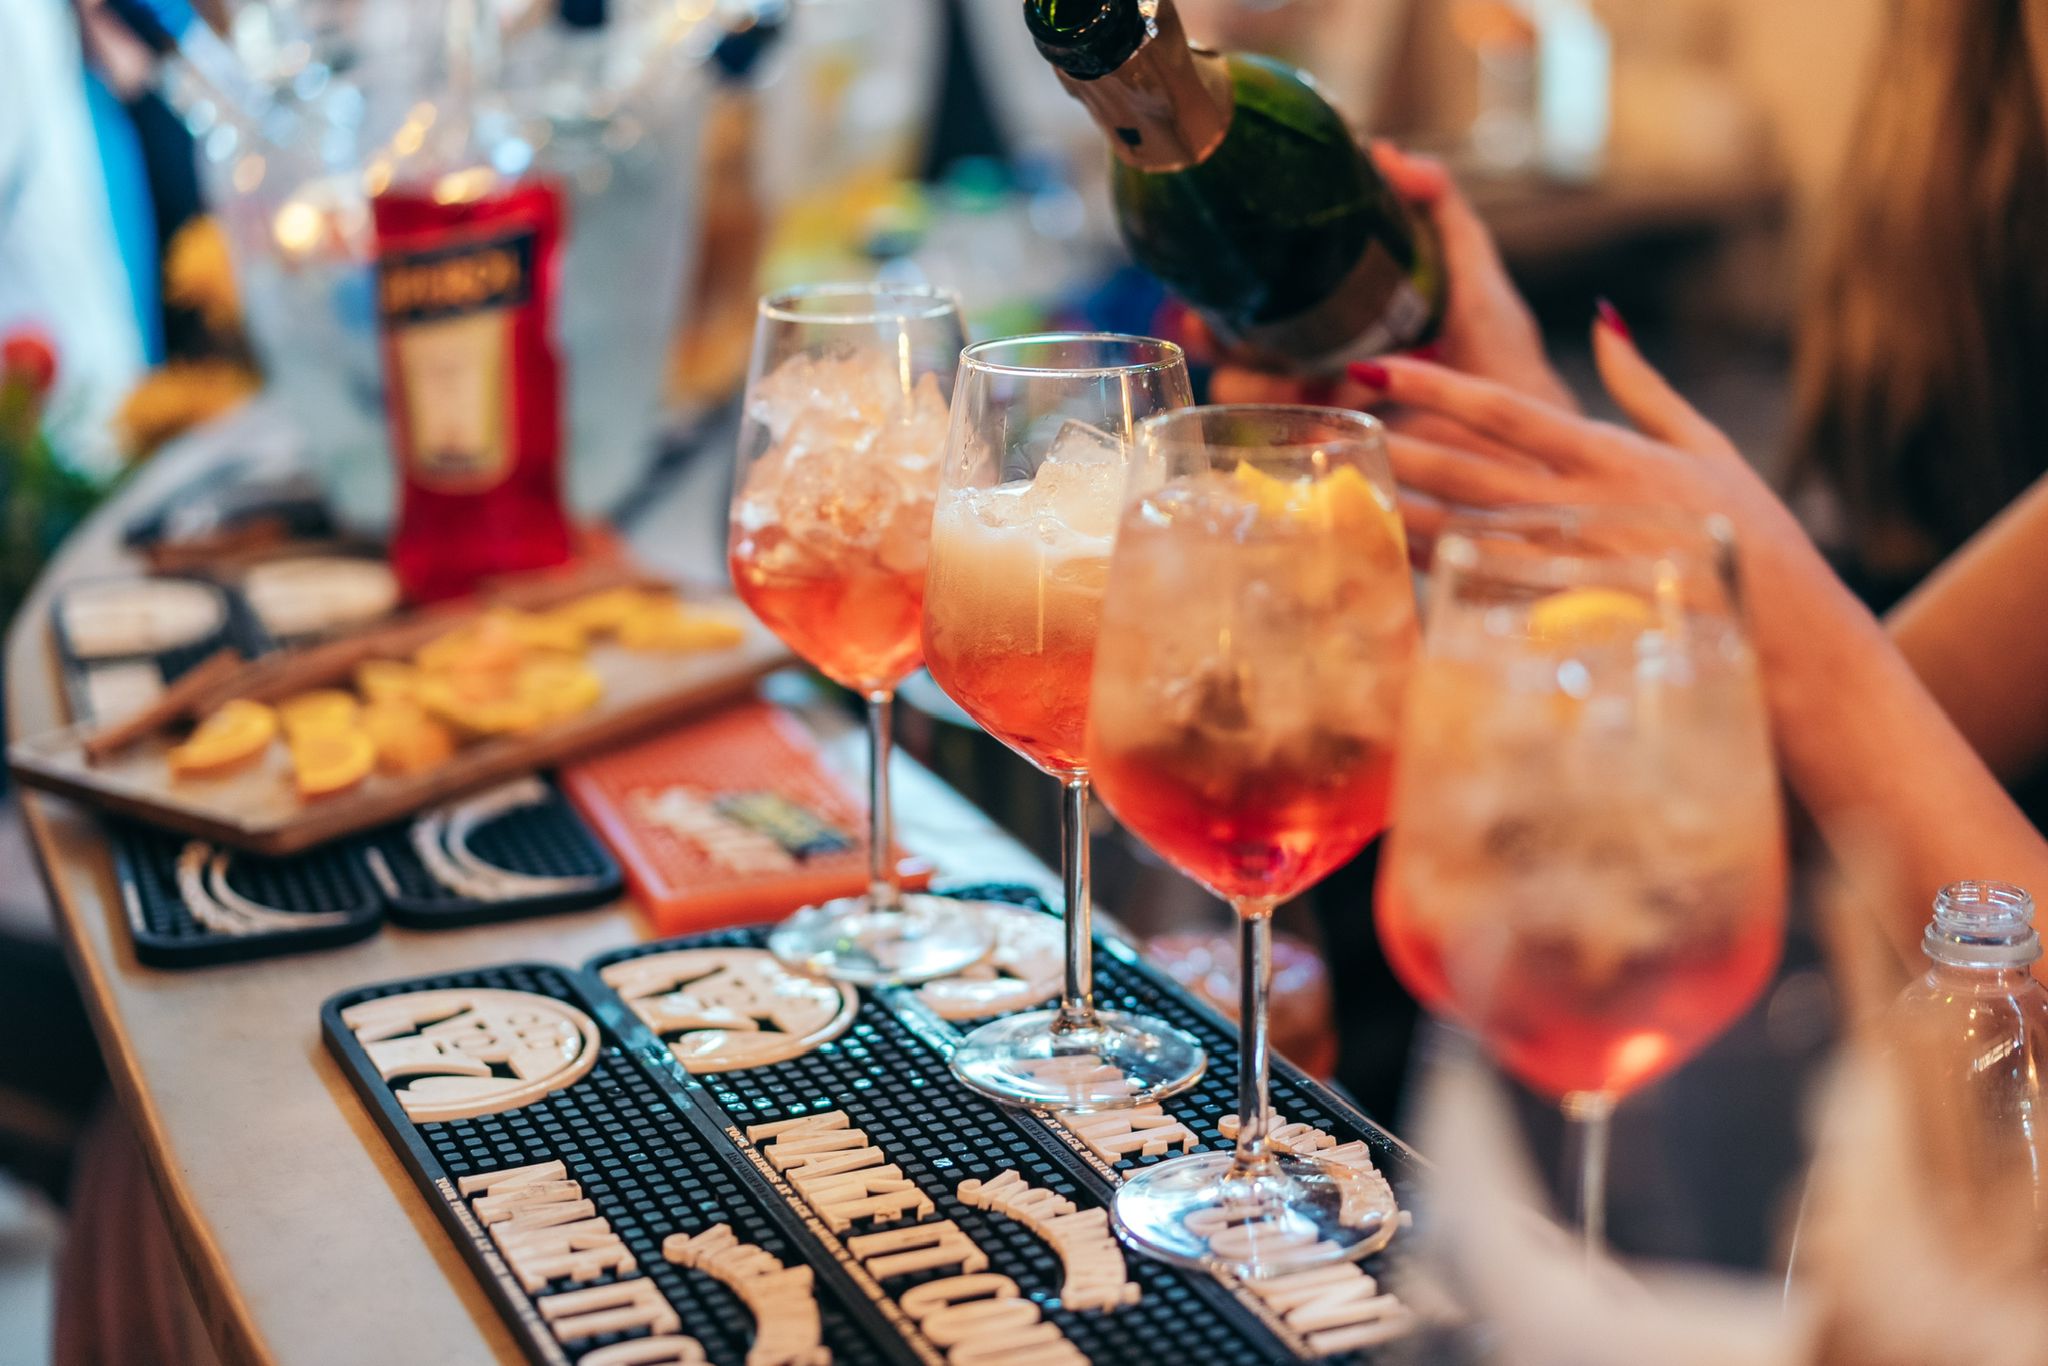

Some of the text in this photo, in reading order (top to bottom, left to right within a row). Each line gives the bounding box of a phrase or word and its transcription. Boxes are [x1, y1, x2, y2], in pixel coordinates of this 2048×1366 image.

[724, 1125, 750, 1149] YOUR
[744, 1145, 783, 1184] FRIENDS
[1056, 1129, 1086, 1151] JACK
[457, 1159, 638, 1294] MAKE
[746, 1109, 935, 1236] MAKE
[847, 1219, 990, 1282] IT
[537, 1276, 681, 1340] IT
